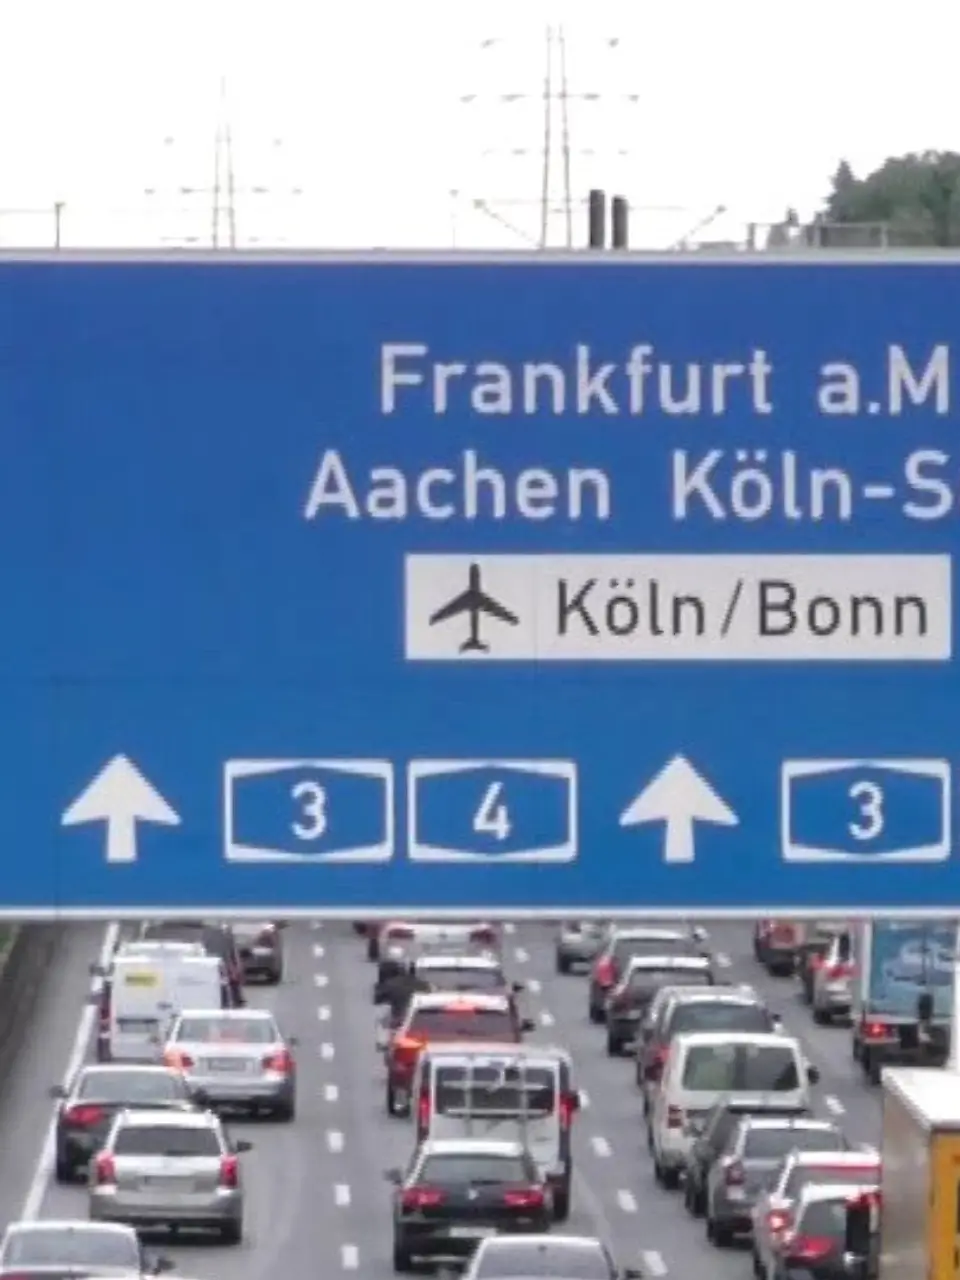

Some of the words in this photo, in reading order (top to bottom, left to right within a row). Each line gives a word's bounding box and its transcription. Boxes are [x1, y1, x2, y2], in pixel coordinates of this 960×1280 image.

[381, 343, 772, 415] Frankfurt
[304, 449, 610, 520] Aachen
[292, 780, 327, 840] 3
[473, 781, 511, 840] 4
[849, 780, 885, 840] 3
